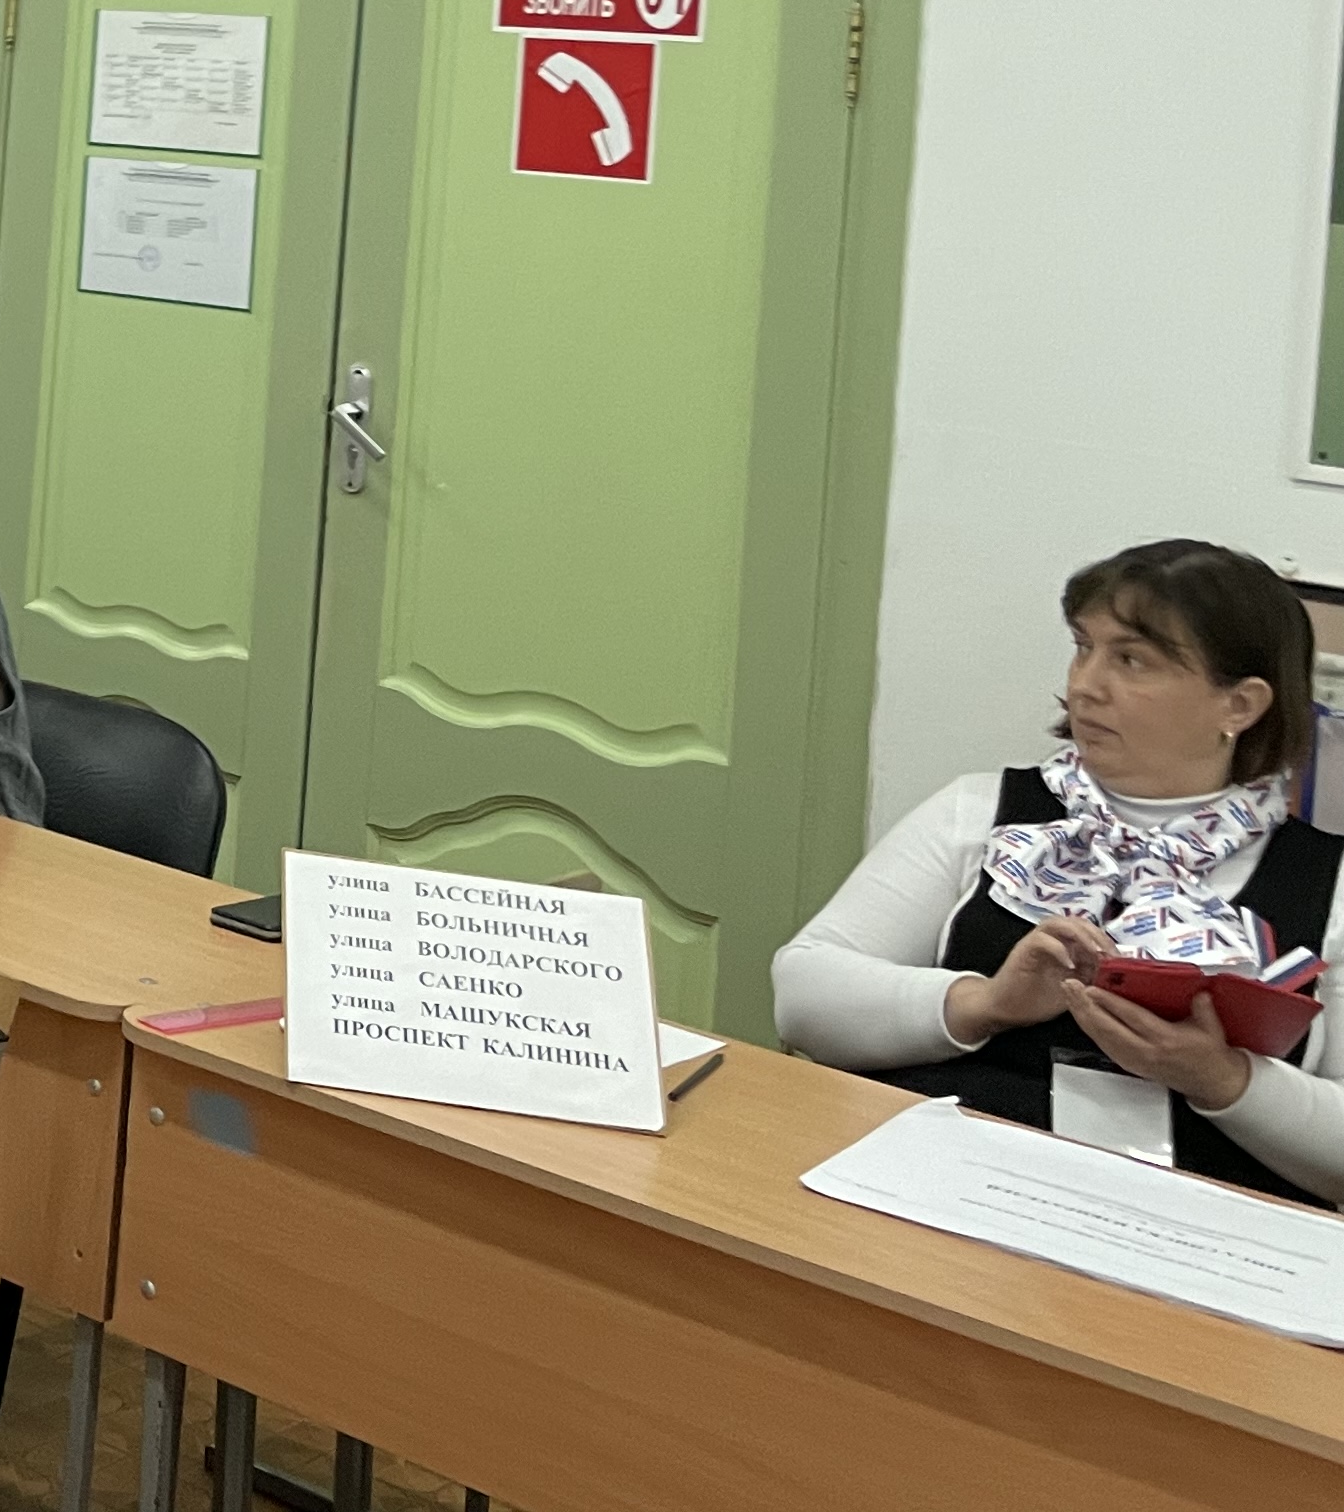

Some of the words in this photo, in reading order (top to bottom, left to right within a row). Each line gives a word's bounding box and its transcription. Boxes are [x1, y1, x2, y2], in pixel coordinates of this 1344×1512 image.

[328, 874, 390, 893] улица
[415, 881, 566, 915] БАССЕЙНАЯ
[329, 902, 391, 922] улица
[416, 911, 589, 947] БОЛЬНИЧНАЯ
[330, 932, 392, 952] улица
[418, 940, 623, 982] ВОЛОДАРСКОГО
[330, 962, 394, 982] улица
[419, 971, 522, 999] САЕНКО
[331, 993, 396, 1013] улица
[421, 1001, 592, 1039] МАШУКСКАЯ
[333, 1018, 469, 1051] ПРОСПЕКТ
[483, 1038, 629, 1073] КАЛИНИНА
